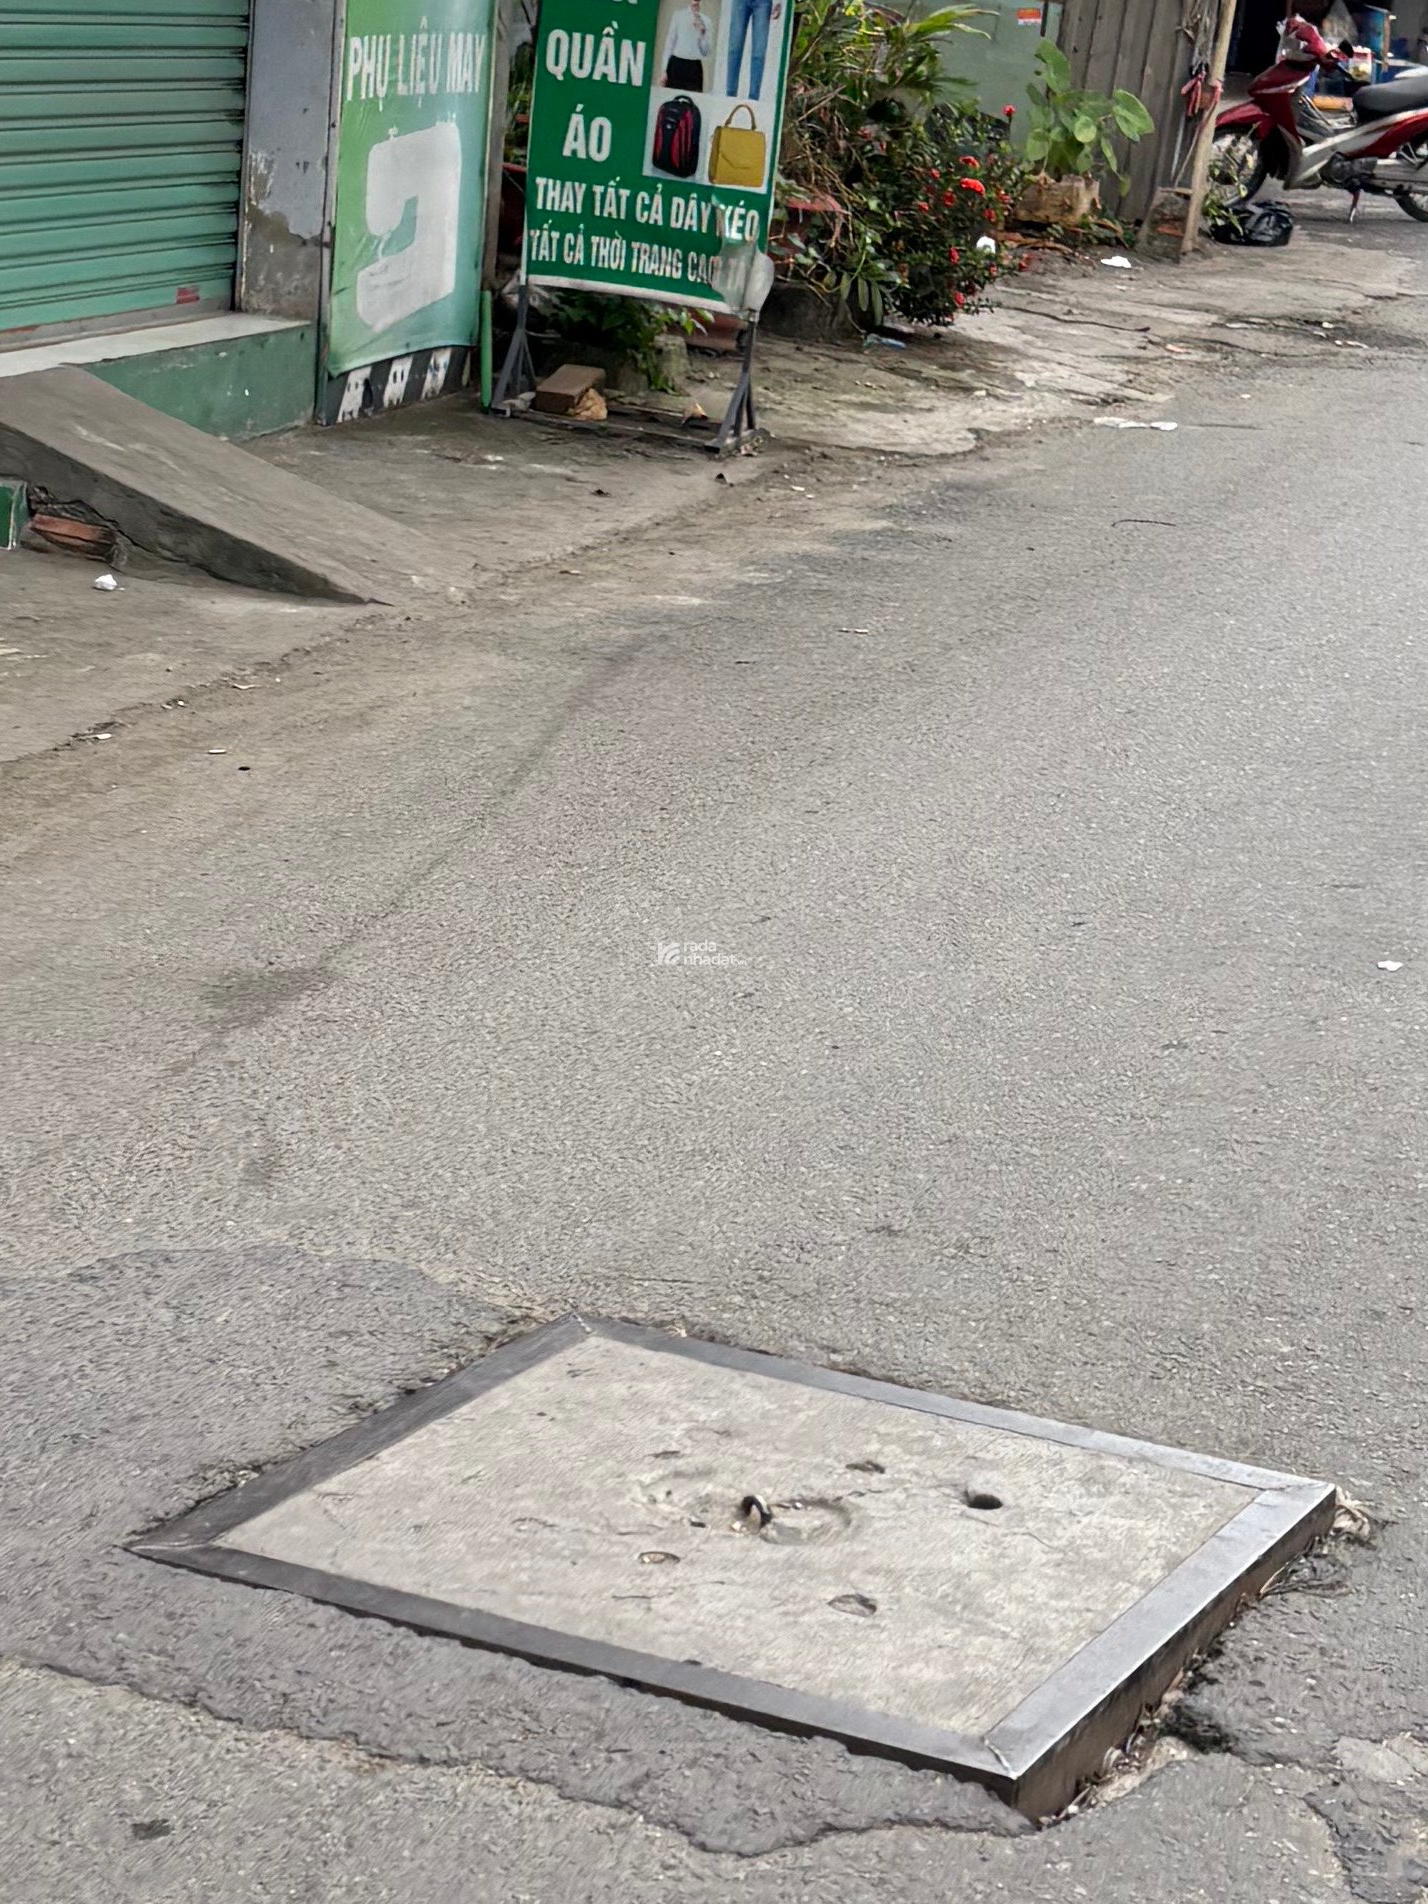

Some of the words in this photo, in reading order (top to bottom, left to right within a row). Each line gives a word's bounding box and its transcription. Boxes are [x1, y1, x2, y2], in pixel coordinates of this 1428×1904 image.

[346, 34, 391, 113] PHỤ
[397, 15, 443, 108] LIỆU
[446, 31, 487, 94] MAY
[545, 21, 647, 88] QUẦN
[562, 103, 612, 164] ÁO
[535, 176, 587, 214] THAY
[592, 176, 630, 220] TẤT
[635, 182, 663, 226] CẢ
[670, 192, 712, 233] DÂY
[529, 219, 560, 262] TẤT
[563, 223, 585, 266] CẢ
[590, 230, 627, 271] THỜI
[631, 241, 683, 279] TRANG
